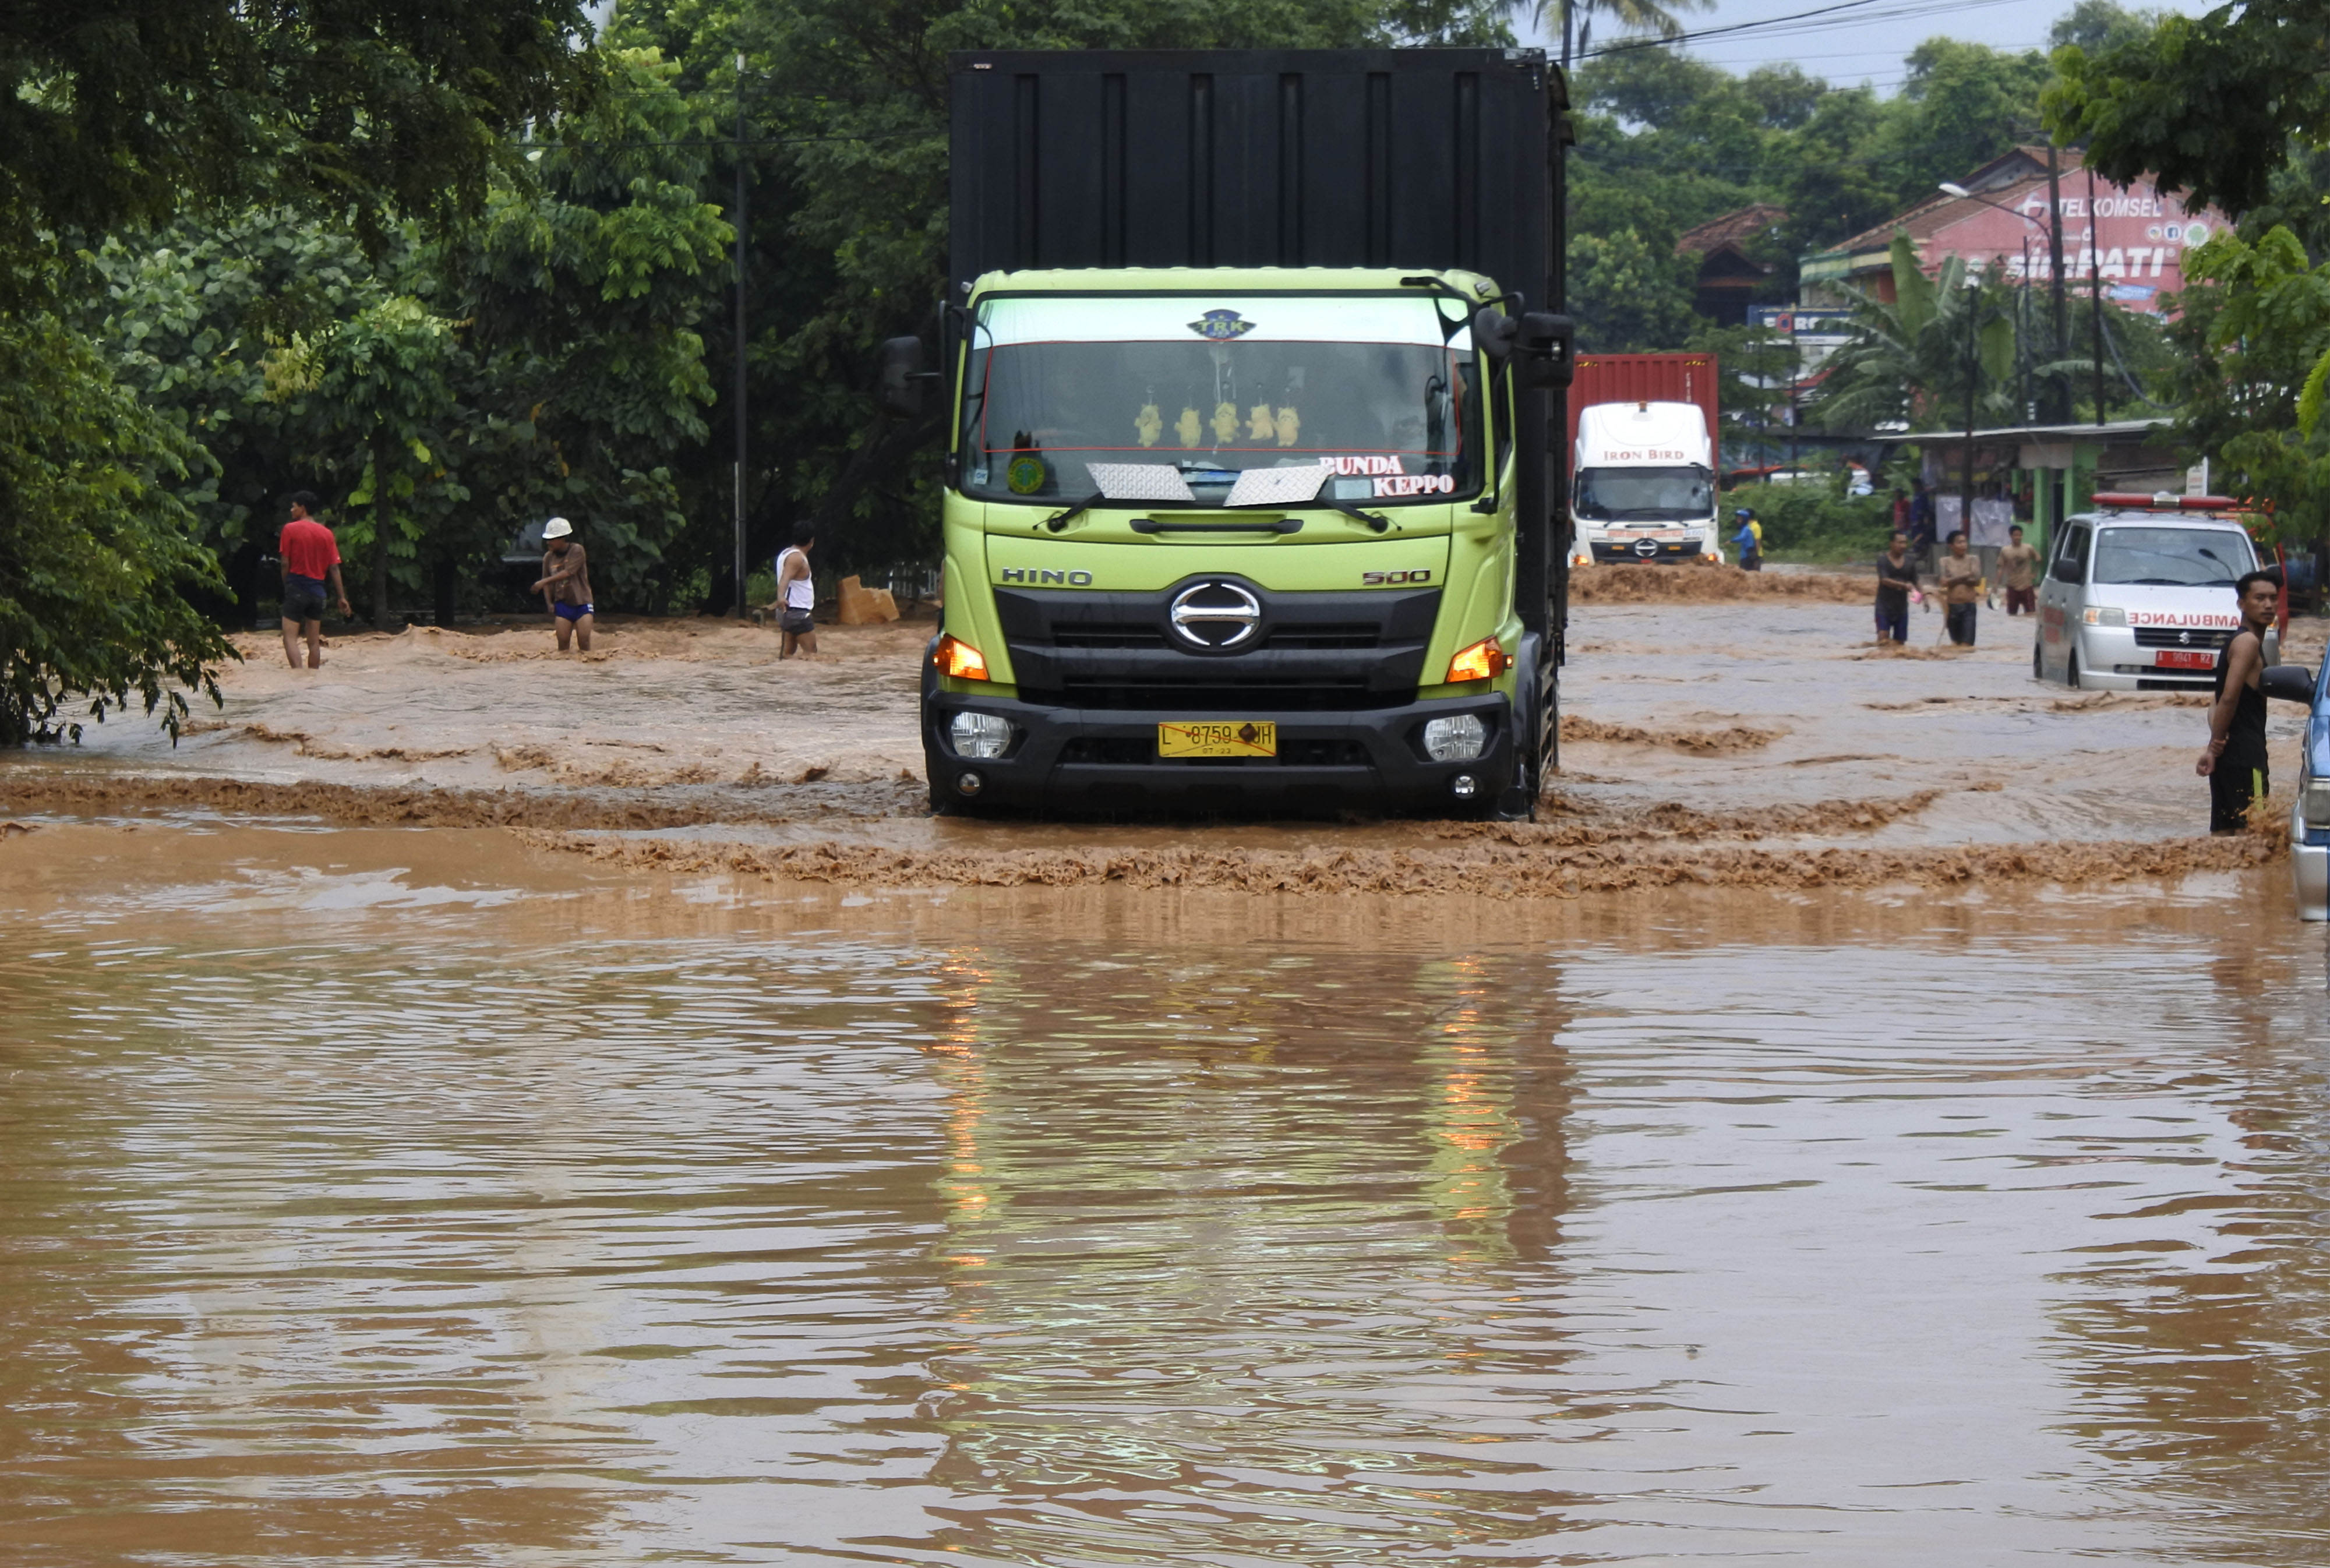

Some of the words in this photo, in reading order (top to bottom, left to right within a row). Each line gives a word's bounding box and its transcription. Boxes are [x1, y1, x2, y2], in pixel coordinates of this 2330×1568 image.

[2059, 197, 2162, 217] TELKOMSEL
[1198, 321, 1245, 332] TRK
[1372, 474, 1455, 497] KEPPO
[1002, 567, 1093, 586] HINO
[1362, 568, 1431, 585] 500
[1163, 728, 1171, 744] L
[1191, 726, 1231, 744] 8759
